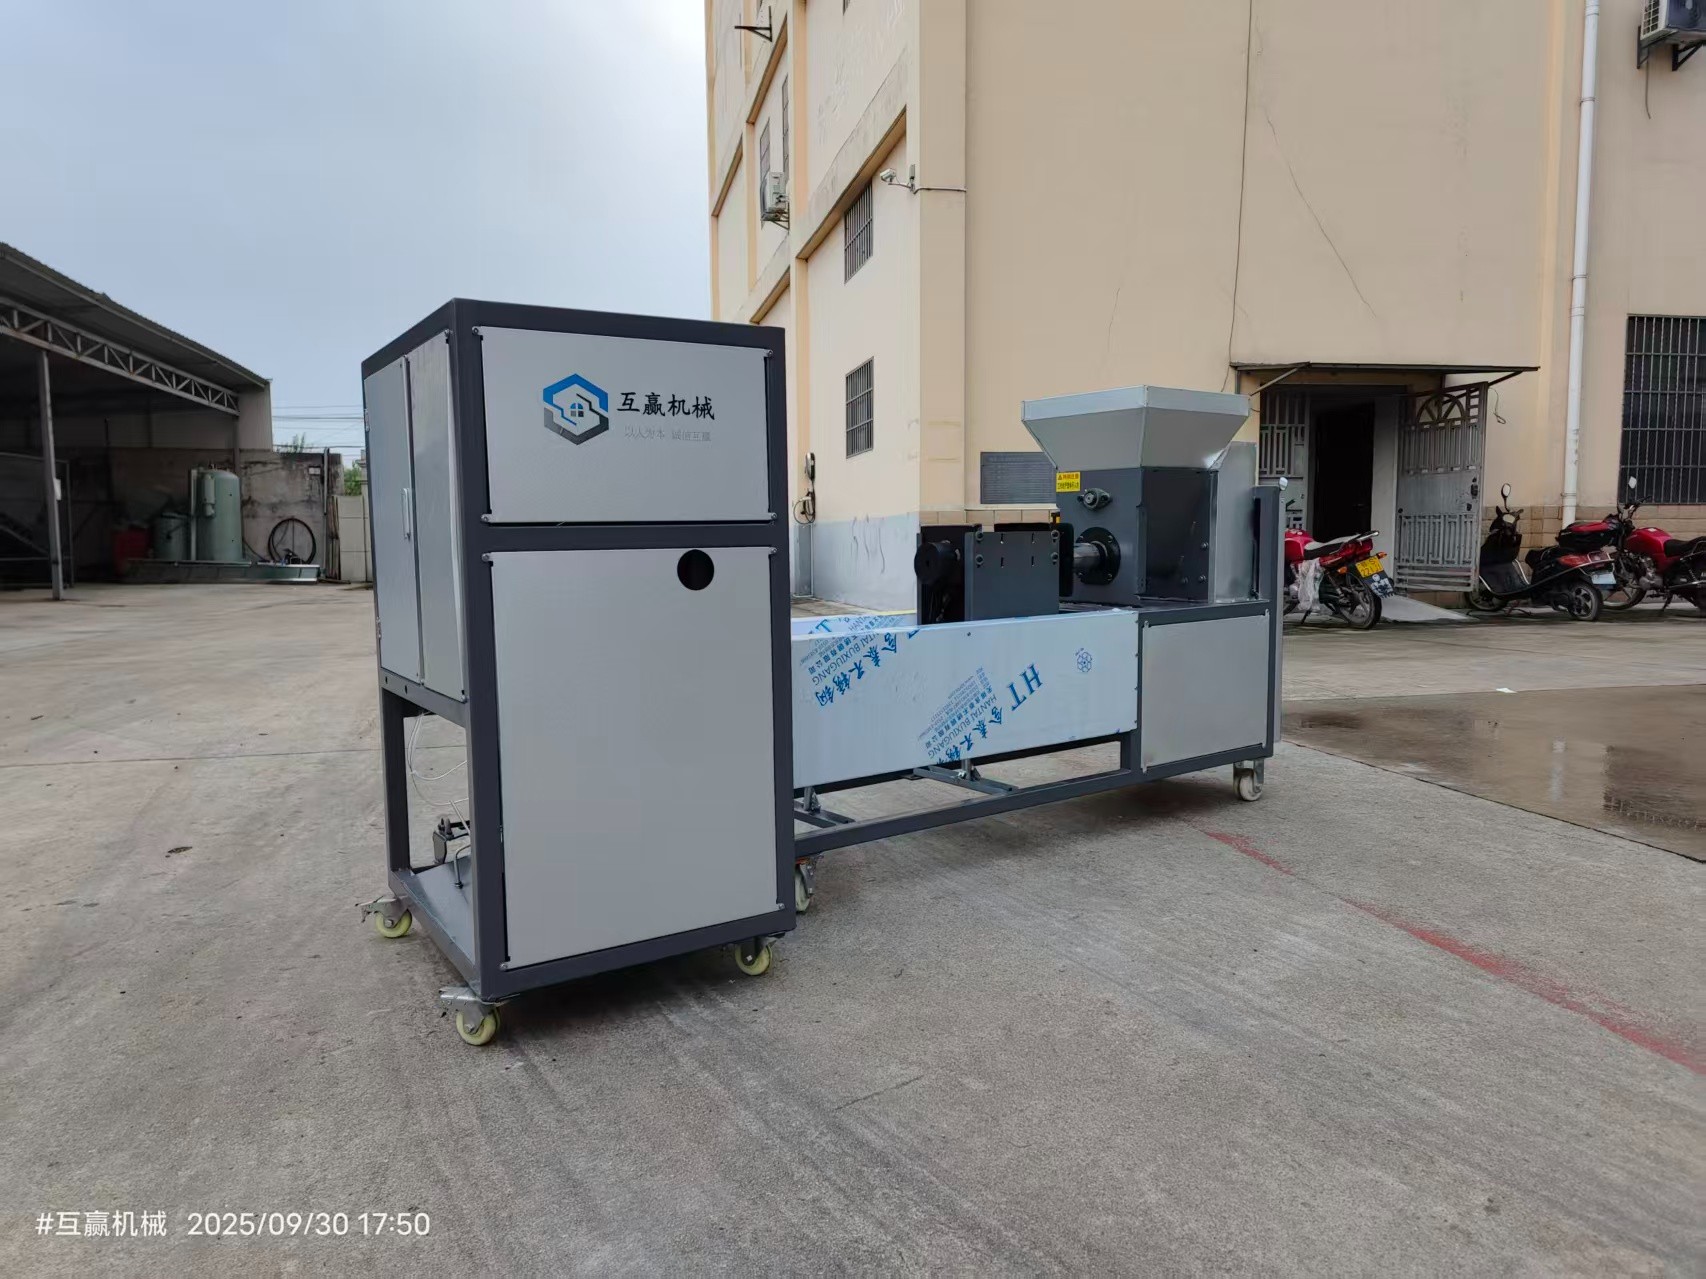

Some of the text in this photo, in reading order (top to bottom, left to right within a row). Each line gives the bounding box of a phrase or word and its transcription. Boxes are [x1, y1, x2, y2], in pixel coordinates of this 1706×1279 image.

[616, 391, 715, 420] 互赢机械
[812, 644, 861, 686] BUXIUGANG
[970, 694, 998, 718] HANTAI
[1004, 663, 1043, 711] HT
[927, 717, 971, 759] BUXIUGANG
